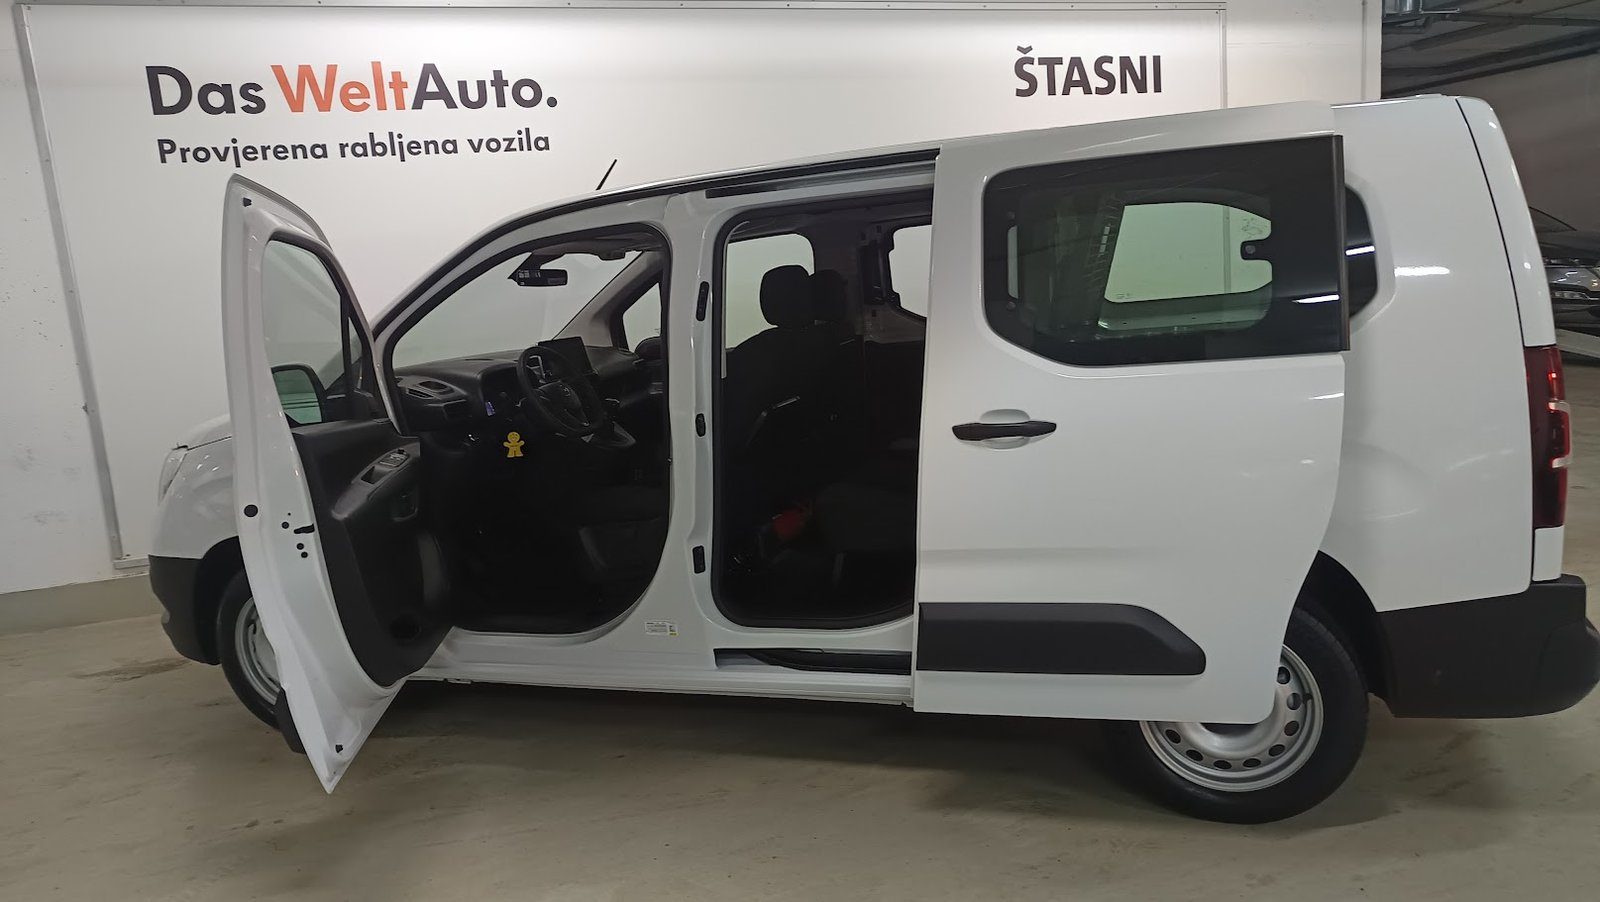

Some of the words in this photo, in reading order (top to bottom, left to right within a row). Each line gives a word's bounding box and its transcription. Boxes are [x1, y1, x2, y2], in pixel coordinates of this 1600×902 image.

[145, 65, 266, 116] Das
[271, 61, 558, 114] WeltAuto.
[1014, 45, 1162, 97] ŠTASNI
[157, 138, 328, 168] Provjerena
[338, 131, 459, 162] rabljena
[467, 127, 550, 153] vozila
